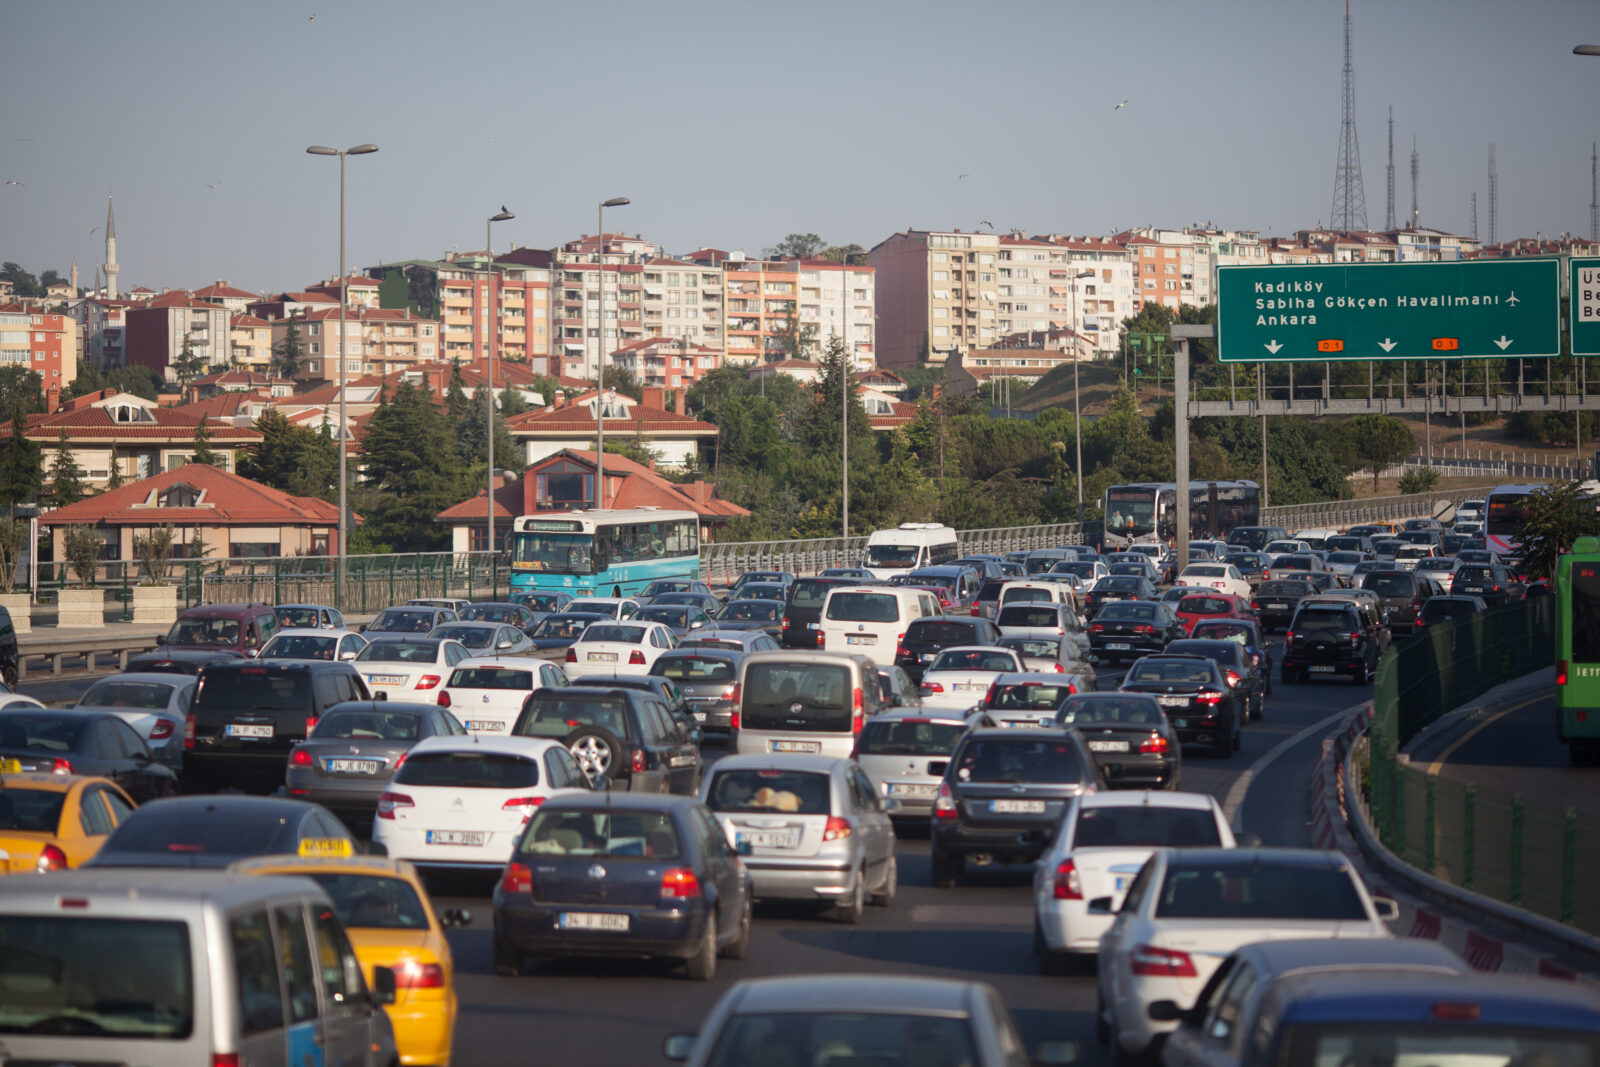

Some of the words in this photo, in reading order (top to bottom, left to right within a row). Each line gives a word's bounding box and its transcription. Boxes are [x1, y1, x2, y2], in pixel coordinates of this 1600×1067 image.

[1254, 281, 1323, 294] Kadıköy
[1325, 296, 1388, 310] Gökçen
[1398, 295, 1499, 308] Havalimanı
[1256, 314, 1317, 326] Ankara
[253, 727, 270, 735] 4750
